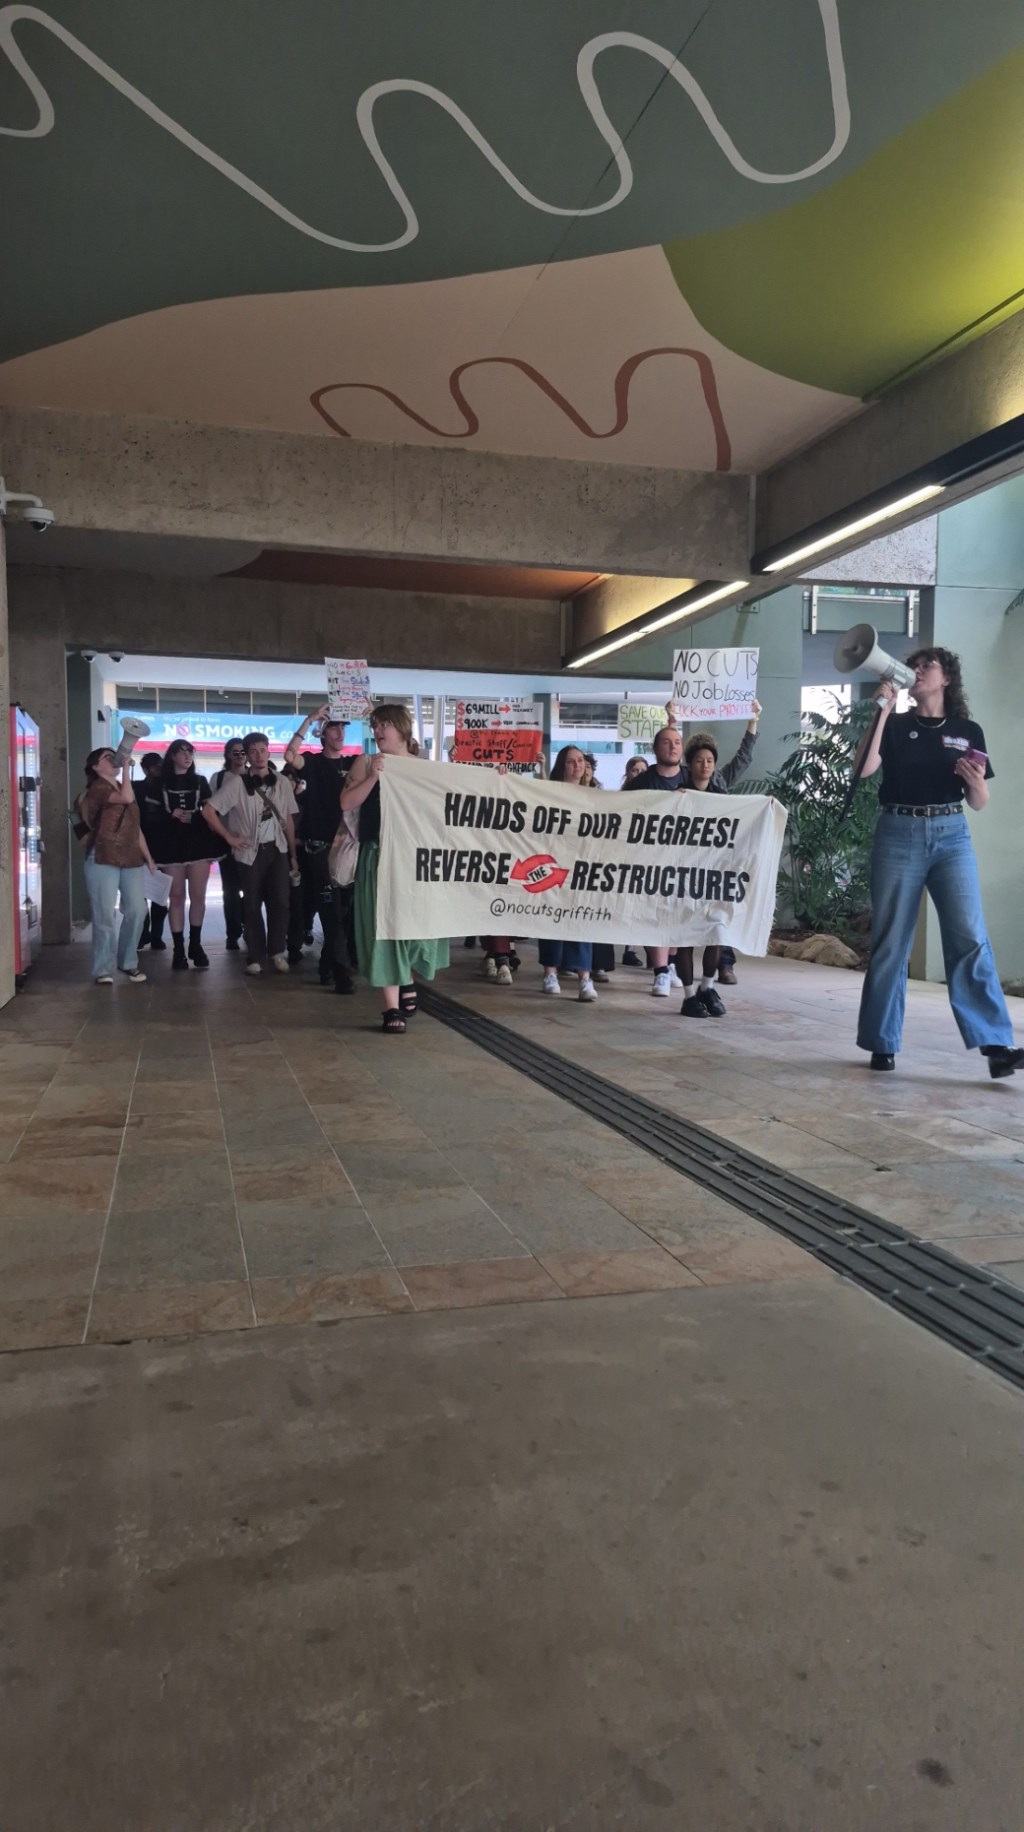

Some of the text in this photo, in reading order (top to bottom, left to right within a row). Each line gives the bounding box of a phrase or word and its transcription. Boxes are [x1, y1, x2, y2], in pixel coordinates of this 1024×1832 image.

[674, 650, 759, 680] NO CUTS
[672, 680, 689, 699] NO
[620, 704, 648, 720] SAVE
[195, 724, 275, 740] SMOKING
[472, 747, 514, 761] CUTS
[445, 792, 527, 834] HANDS
[532, 805, 571, 836] OFF
[626, 812, 740, 849] DEGREES!
[416, 847, 750, 904] REVERSE THE RESTRUCTURES
[490, 898, 612, 923] @nocutsgriffith
